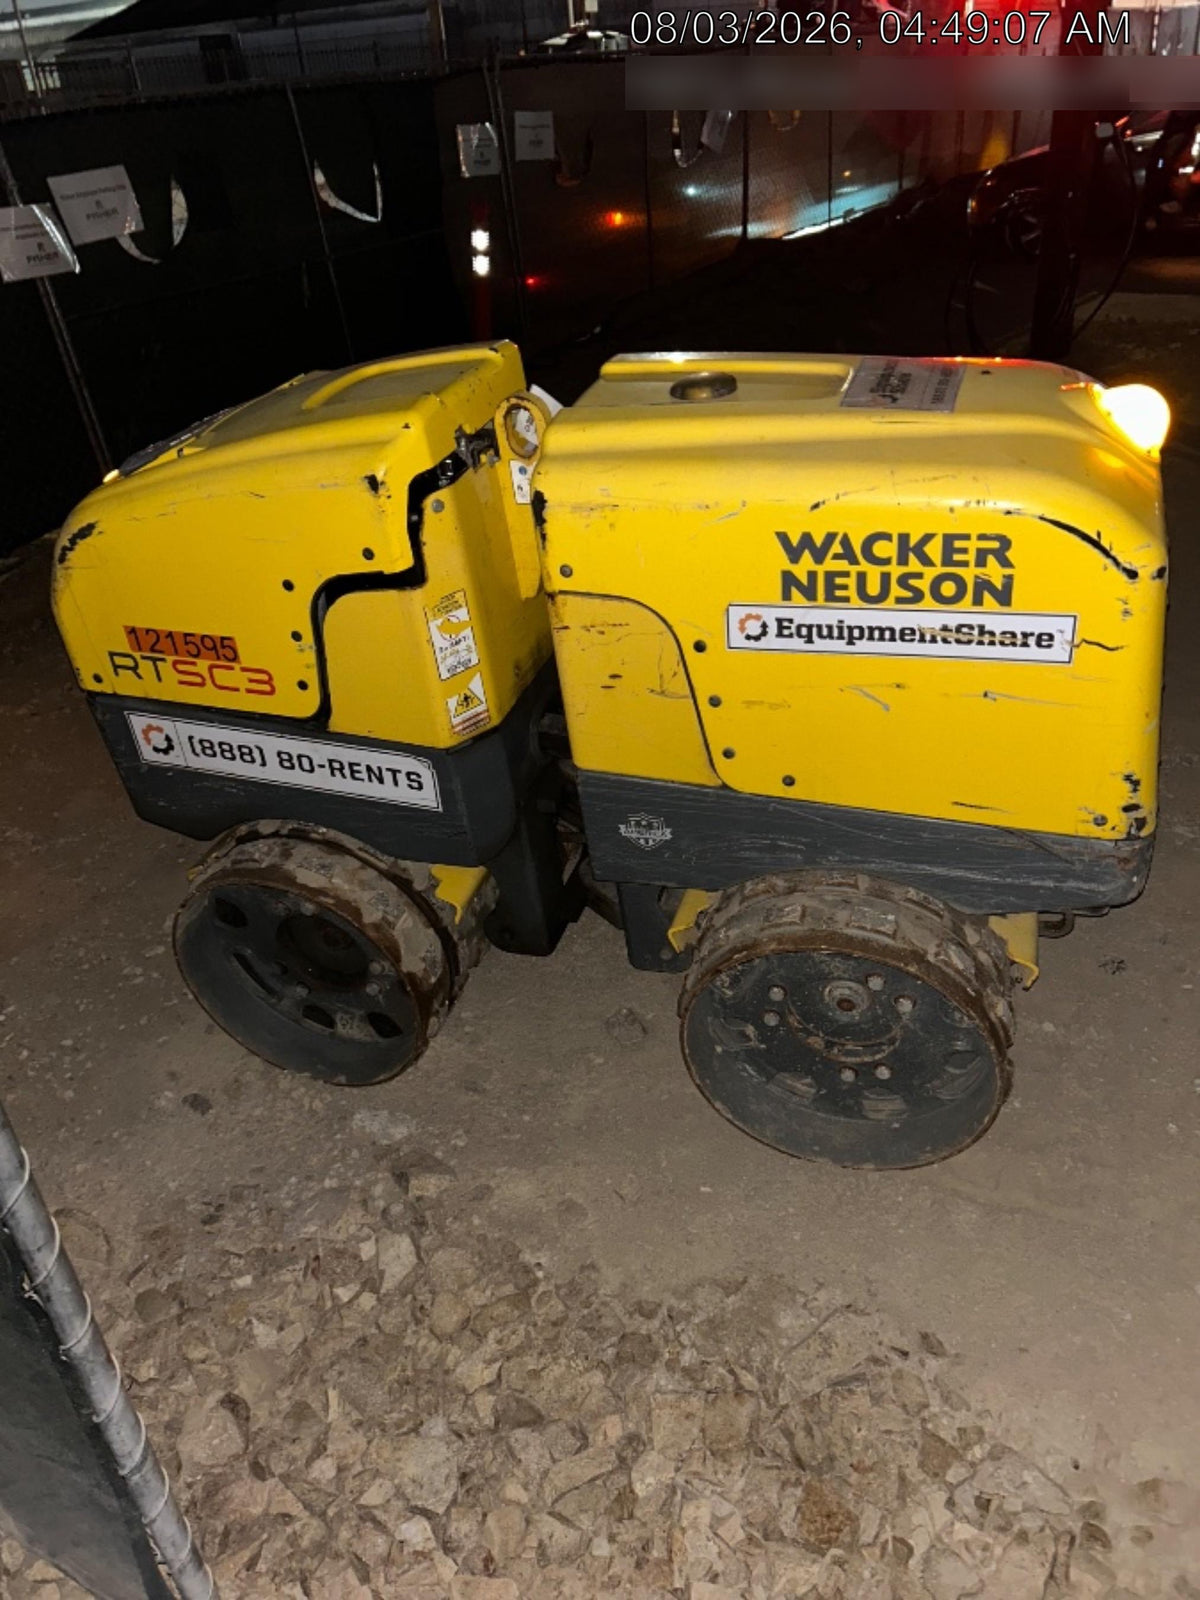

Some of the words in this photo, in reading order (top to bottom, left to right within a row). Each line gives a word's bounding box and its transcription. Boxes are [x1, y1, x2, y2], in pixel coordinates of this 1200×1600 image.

[774, 531, 1016, 568] WACKER
[780, 570, 1014, 607] NEUSON
[127, 626, 238, 662] 121595
[774, 616, 1056, 649] EquipmentShare
[107, 650, 277, 696] RTSC3
[187, 735, 268, 767] (888)
[276, 750, 425, 792] 80-RENTS
